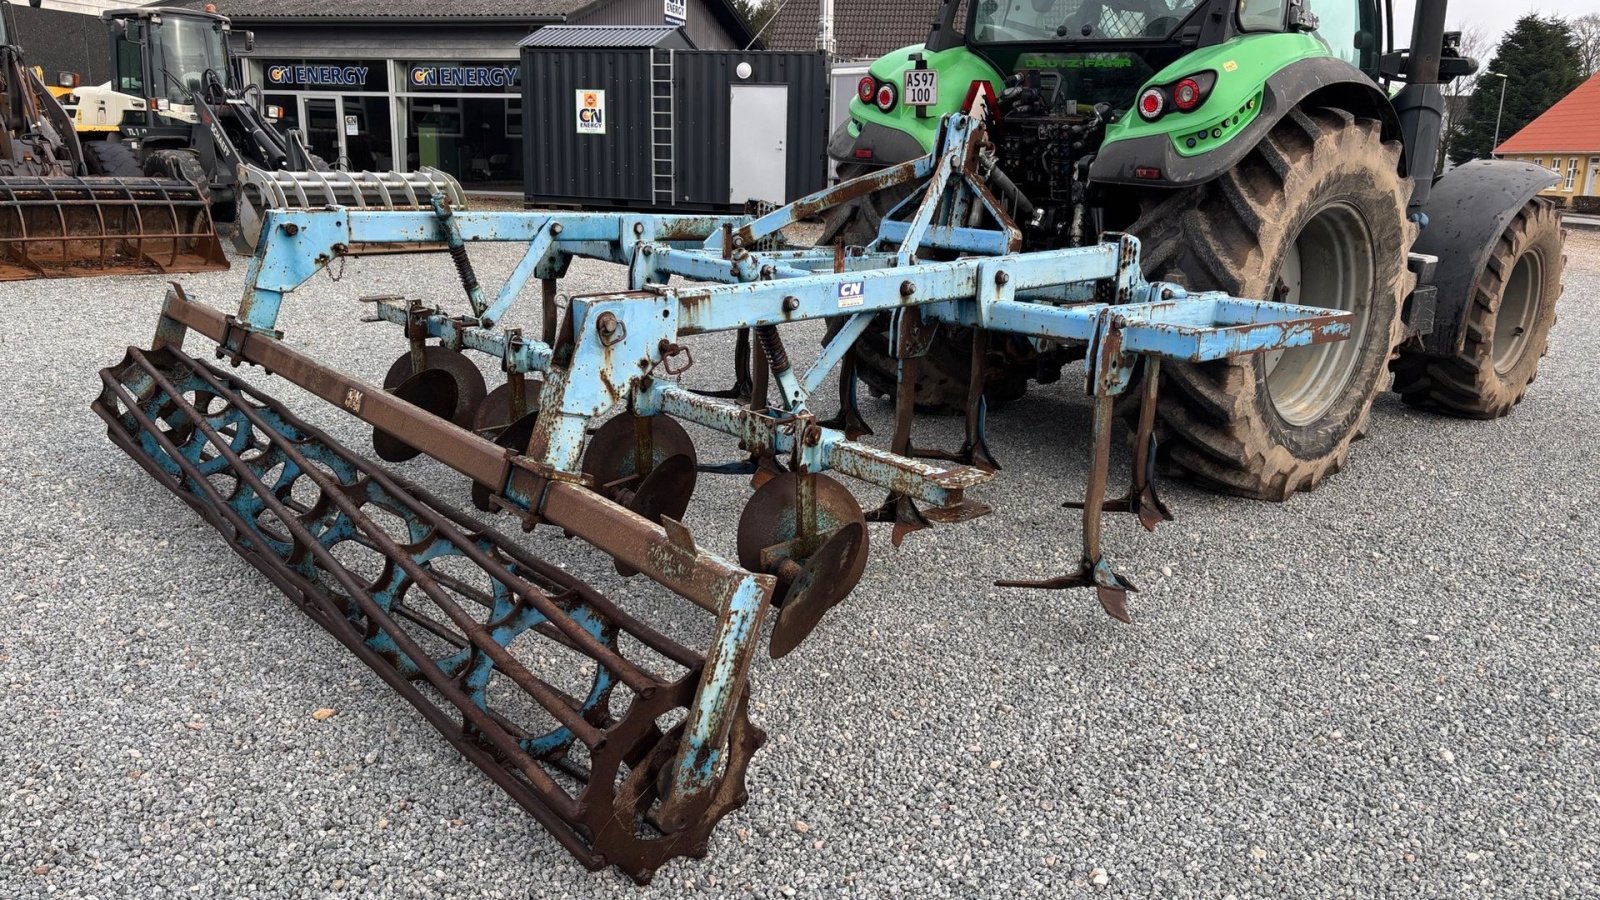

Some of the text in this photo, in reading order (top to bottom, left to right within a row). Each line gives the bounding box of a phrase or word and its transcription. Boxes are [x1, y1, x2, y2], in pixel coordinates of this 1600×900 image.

[666, 2, 685, 16] ENERGY
[268, 65, 368, 85] CN ENERGY
[411, 67, 517, 86] CN ENERGY
[906, 73, 935, 87] AS97
[911, 88, 930, 102] 100
[579, 108, 602, 123] CN
[840, 282, 862, 296] CN
